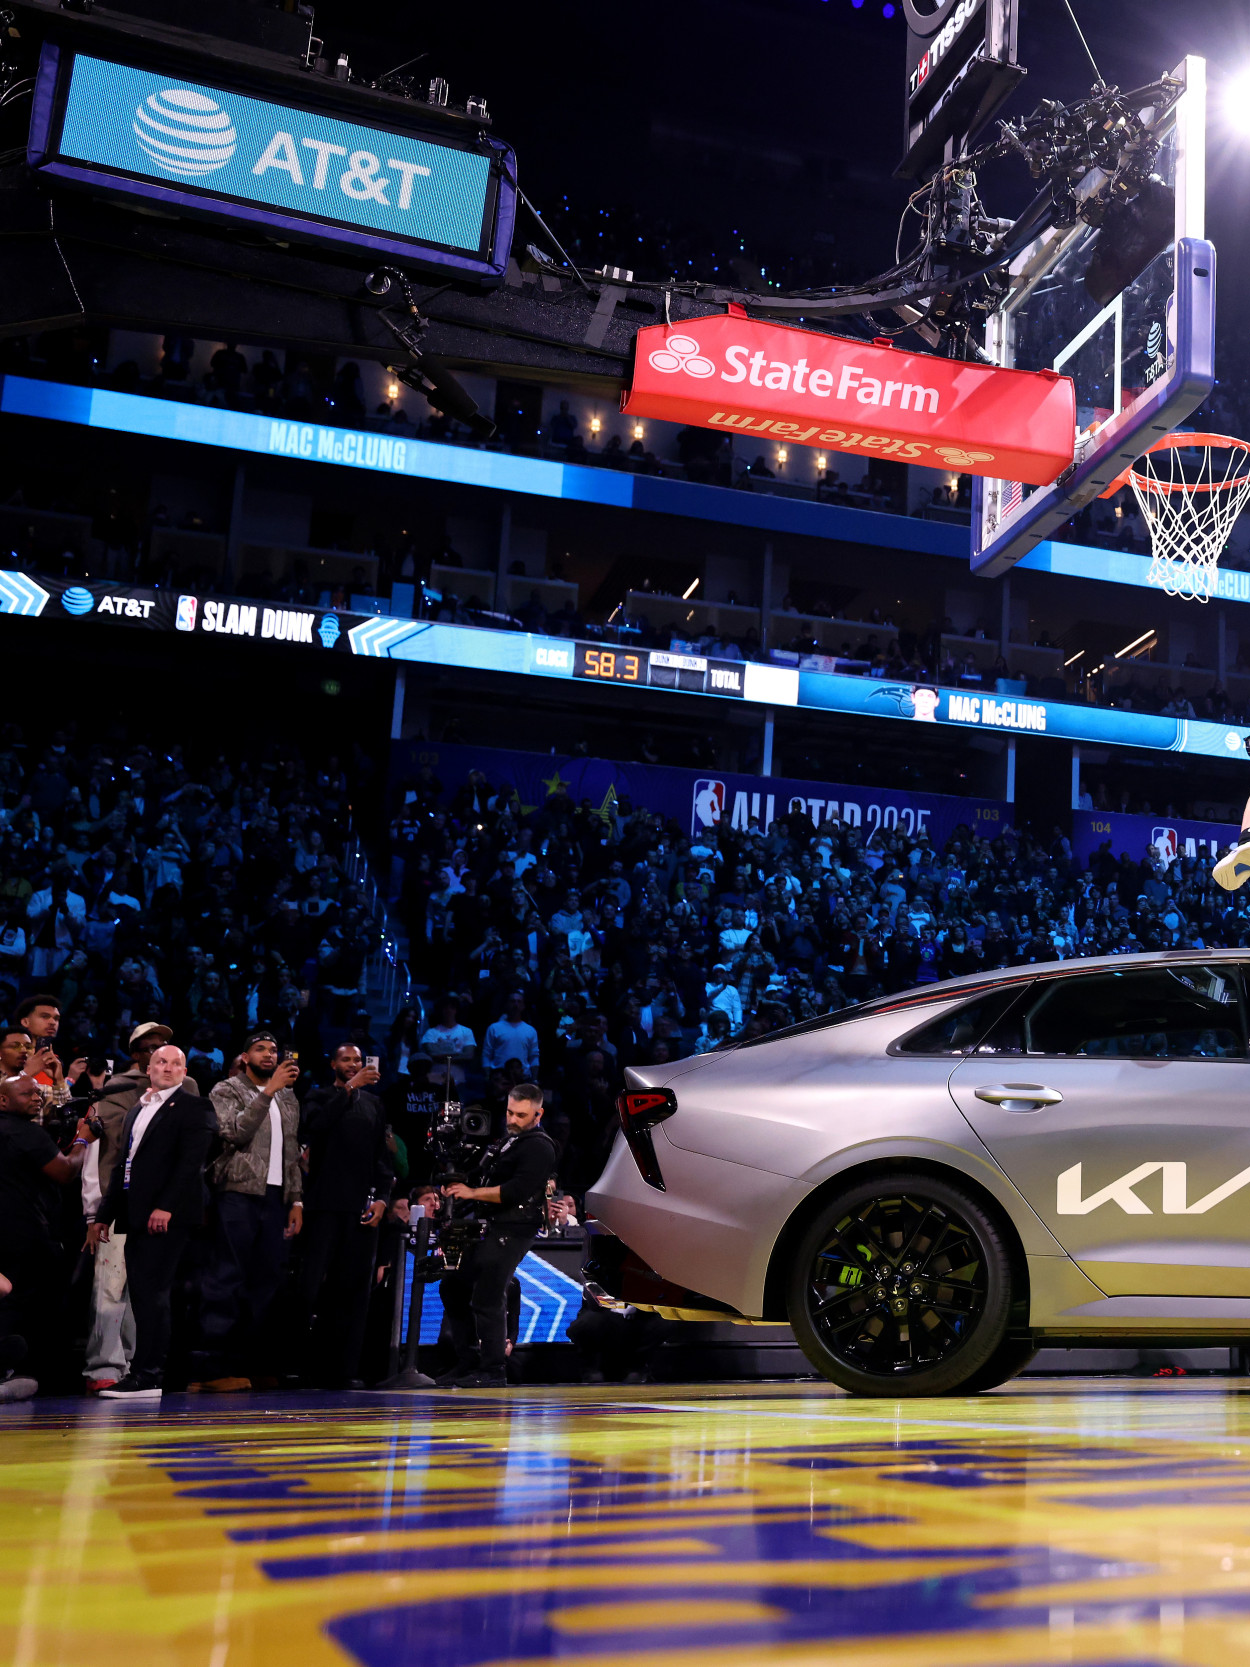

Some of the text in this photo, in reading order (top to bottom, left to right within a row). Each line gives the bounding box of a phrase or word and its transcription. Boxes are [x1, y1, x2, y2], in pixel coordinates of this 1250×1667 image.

[252, 131, 431, 210] AT&T
[269, 421, 406, 471] MAC McCLUNG
[97, 595, 155, 618] AT&T
[202, 601, 315, 643] SLAM DUNK
[584, 650, 639, 681] 58.3
[711, 668, 741, 691] TOTAL
[948, 694, 1047, 731] MAC McCLUNG
[975, 807, 999, 822] 103
[1090, 821, 1111, 834] 104
